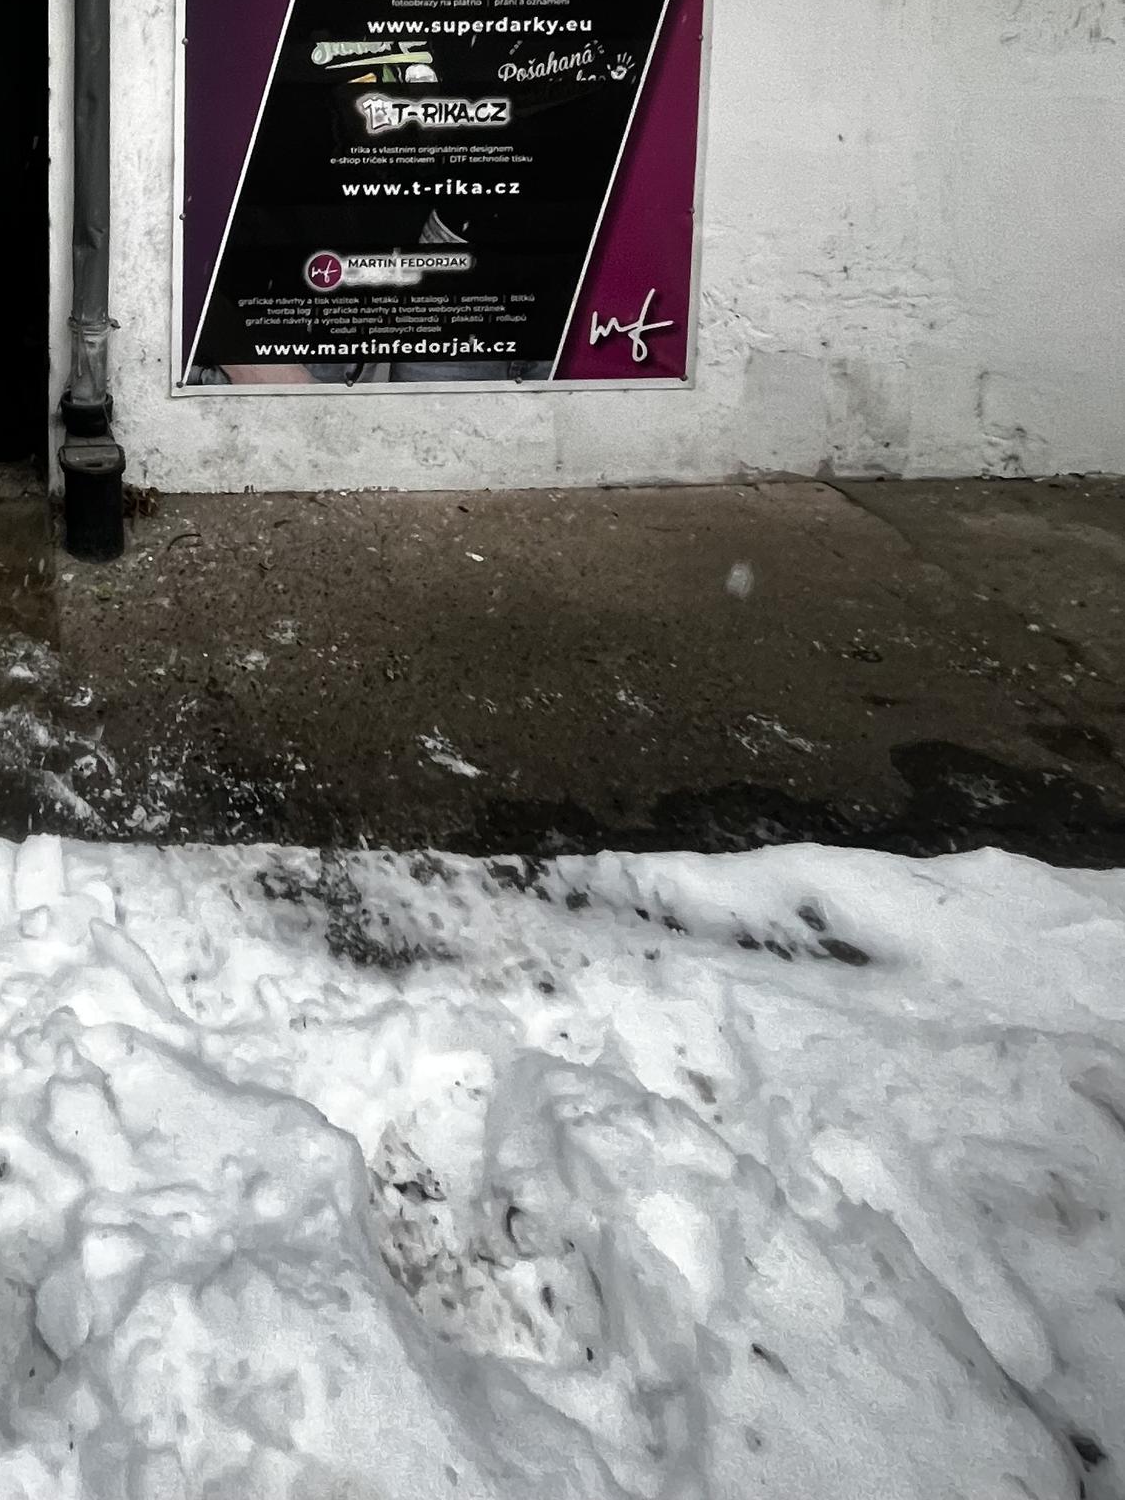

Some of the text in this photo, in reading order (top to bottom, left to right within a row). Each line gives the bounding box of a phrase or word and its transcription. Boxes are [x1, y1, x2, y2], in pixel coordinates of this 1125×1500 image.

[367, 17, 593, 36] www.superdarky.eu
[449, 155, 468, 163] DTF
[342, 179, 521, 196] www.t-rika.cz
[348, 257, 468, 268] MARTIN FEDORJAK
[255, 338, 518, 357] www.martinfedorjak.cz
